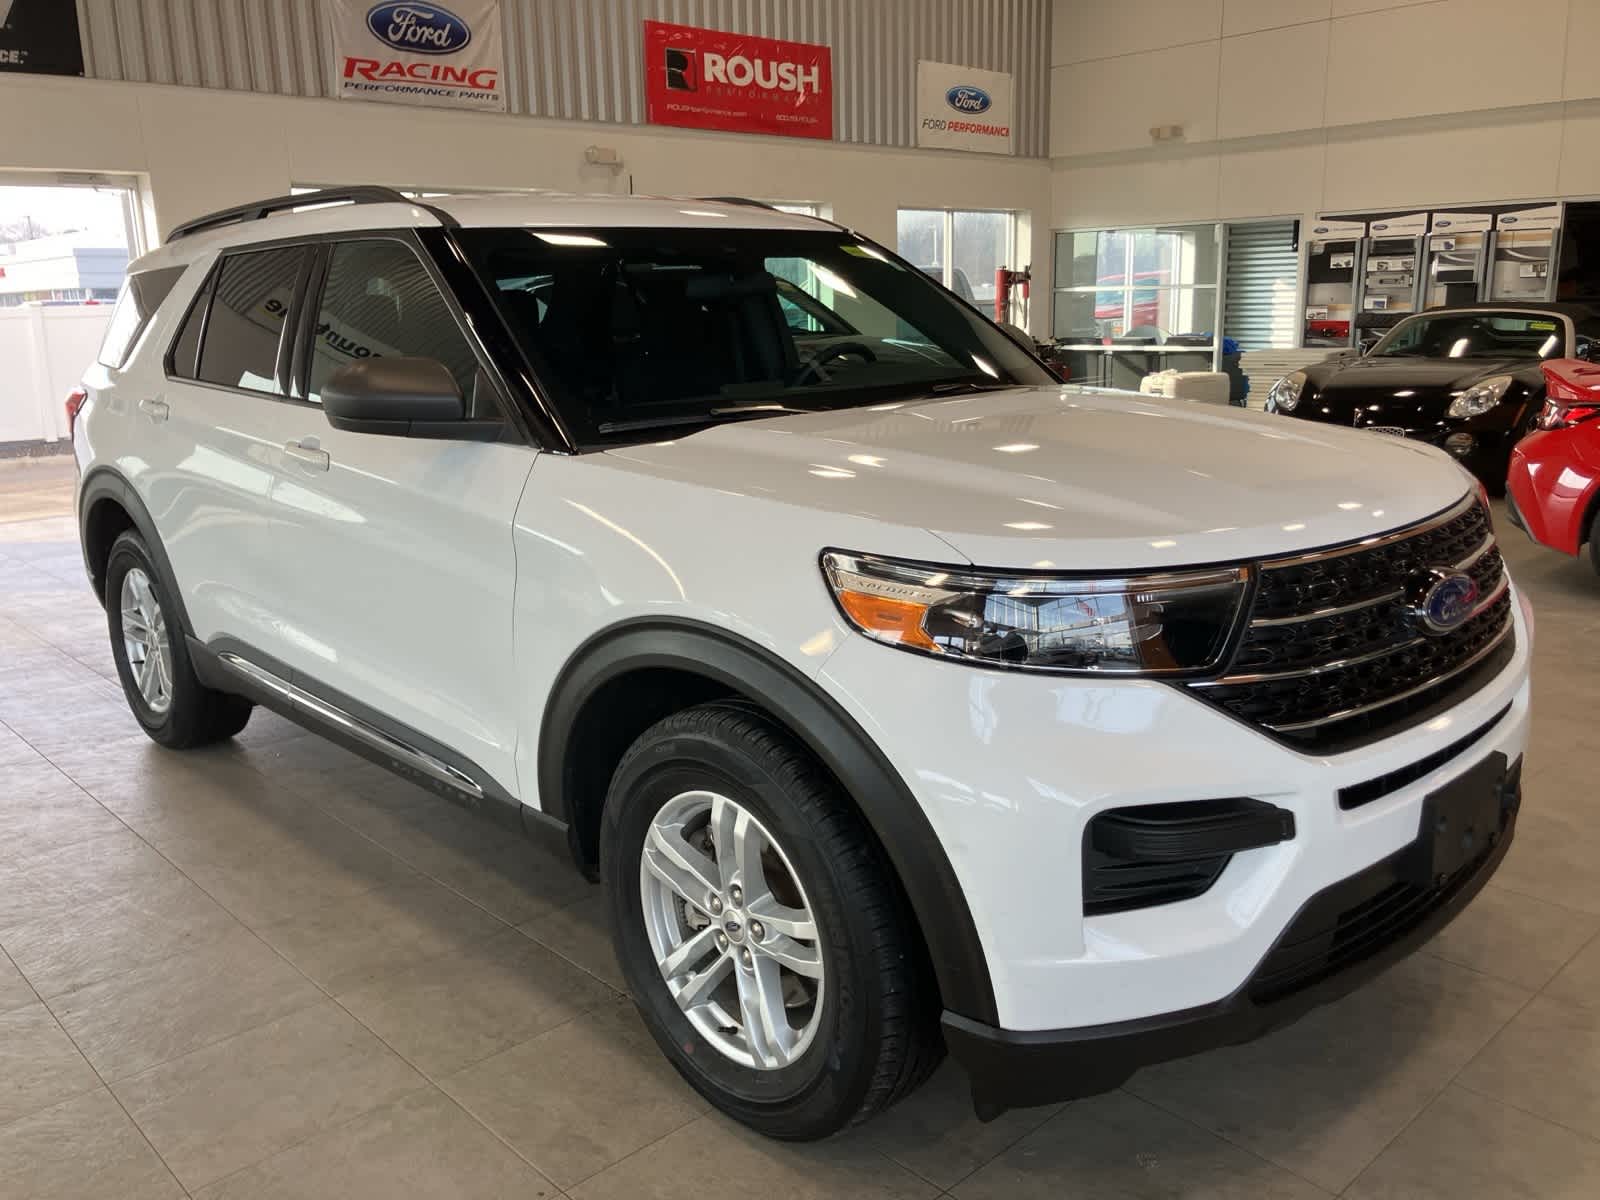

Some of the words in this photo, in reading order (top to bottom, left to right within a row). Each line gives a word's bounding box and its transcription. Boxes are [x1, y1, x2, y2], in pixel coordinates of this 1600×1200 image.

[387, 6, 452, 48] Ford
[343, 56, 498, 91] RACING
[703, 52, 819, 94] ROUSH
[344, 81, 456, 98] PERFORMANCE
[458, 92, 500, 101] PARTS
[955, 89, 983, 110] Ford
[921, 118, 947, 131] FORD
